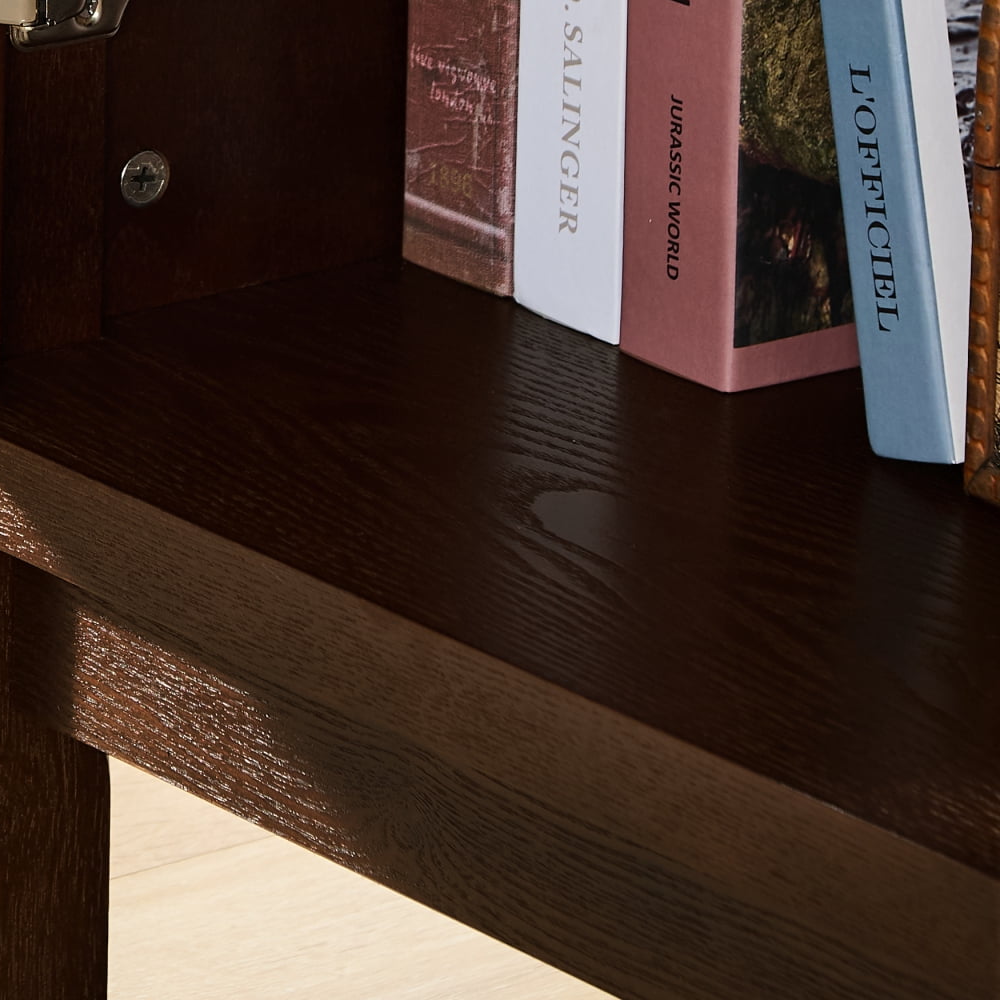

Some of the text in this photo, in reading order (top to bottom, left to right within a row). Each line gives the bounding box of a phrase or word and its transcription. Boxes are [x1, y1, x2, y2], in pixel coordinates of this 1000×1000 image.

[558, 21, 584, 234] SALINGER
[666, 93, 684, 281] JURASSIC WORLD
[848, 63, 900, 333] L'OFFICIEL
